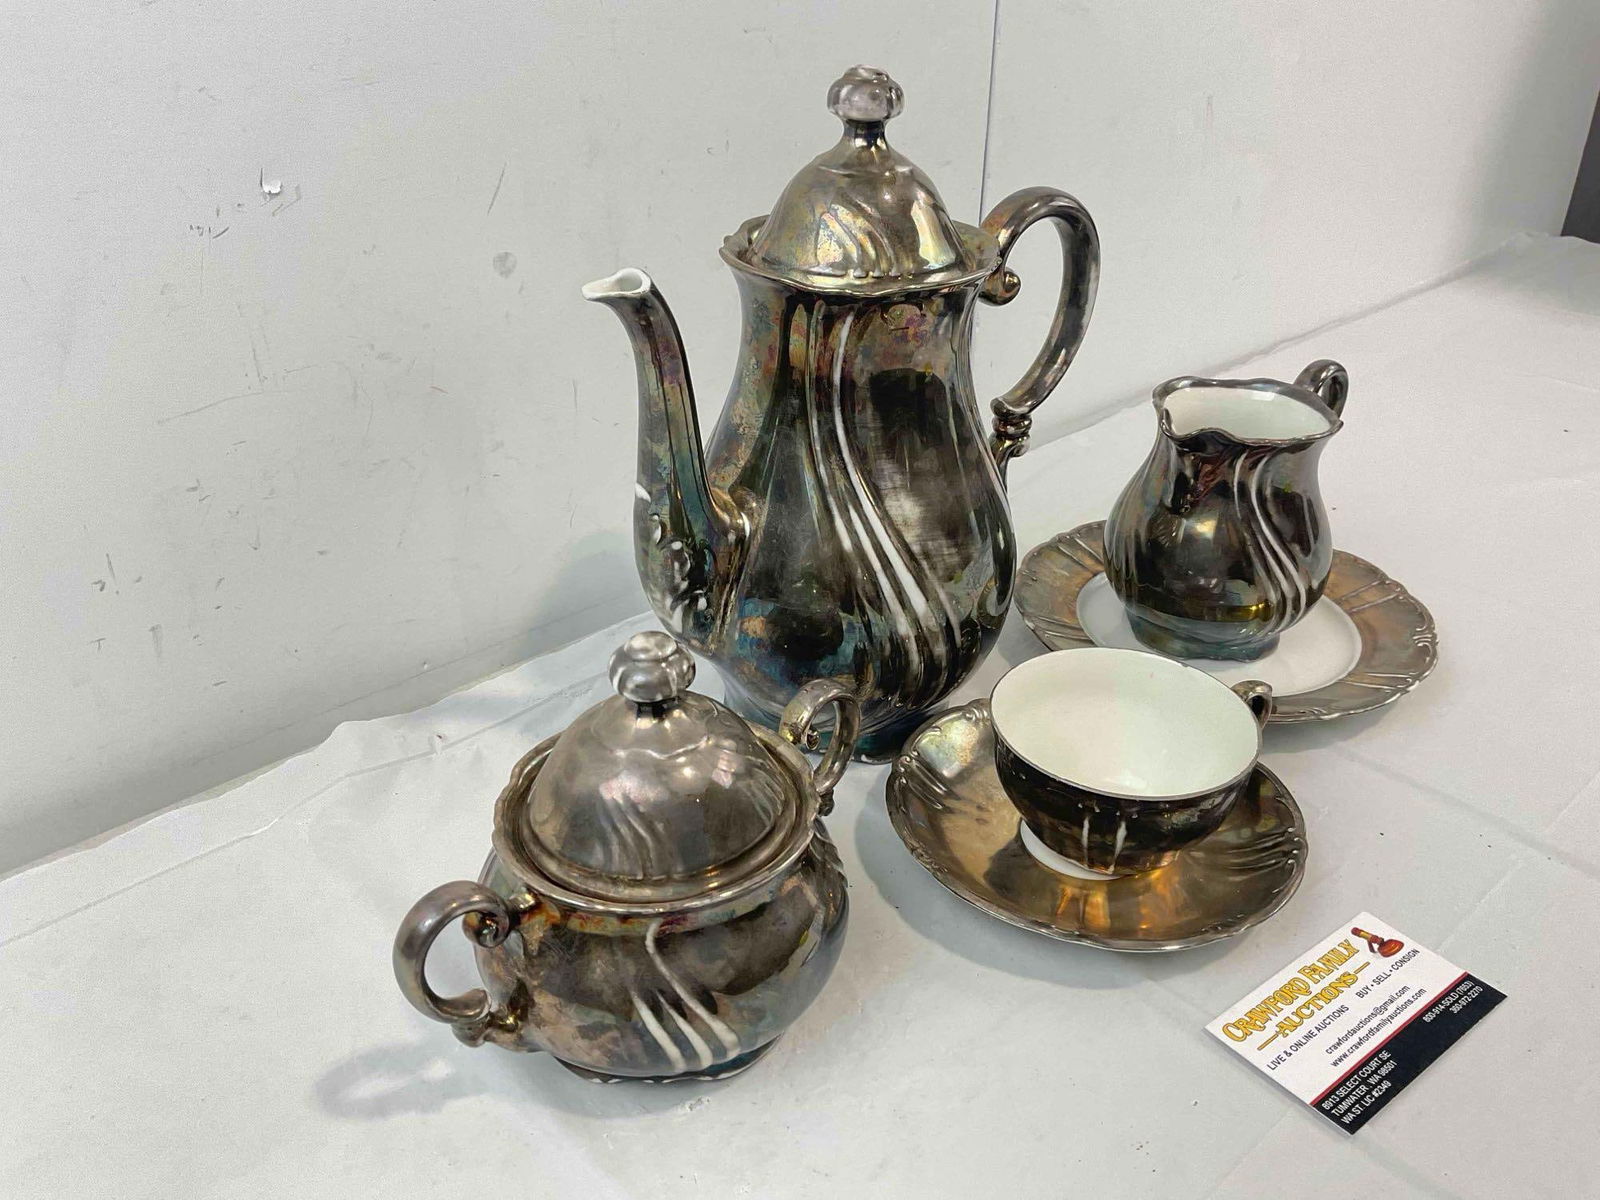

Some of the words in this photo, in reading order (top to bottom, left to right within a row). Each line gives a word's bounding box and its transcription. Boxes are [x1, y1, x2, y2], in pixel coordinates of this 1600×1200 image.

[1221, 976, 1313, 1043] CRAWFORD
[1297, 939, 1361, 984] FAMILY
[1356, 985, 1372, 998] BUY
[1372, 972, 1391, 985] SELL
[1391, 949, 1420, 970] CONSIGN
[1275, 971, 1359, 1038] AUCTIONS
[1325, 985, 1410, 1055] crawfordauctions@gmail.com
[1330, 988, 1427, 1067] www.crawfordfamilyauctions.com
[1422, 992, 1459, 1022] 800-914-SOLD
[1266, 1055, 1286, 1070] LIVE
[1283, 1049, 1292, 1057] &
[1289, 1031, 1317, 1052] ONLINE
[1314, 1005, 1349, 1033] AUCTIONS
[1331, 1085, 1369, 1116] TUMWATER
[1367, 1074, 1382, 1085] WA
[1336, 1075, 1361, 1097] SELECT
[1359, 1058, 1382, 1078] COURT
[1379, 1050, 1391, 1060] SE
[1341, 1113, 1356, 1124] WA
[1361, 1094, 1375, 1106] LIC
